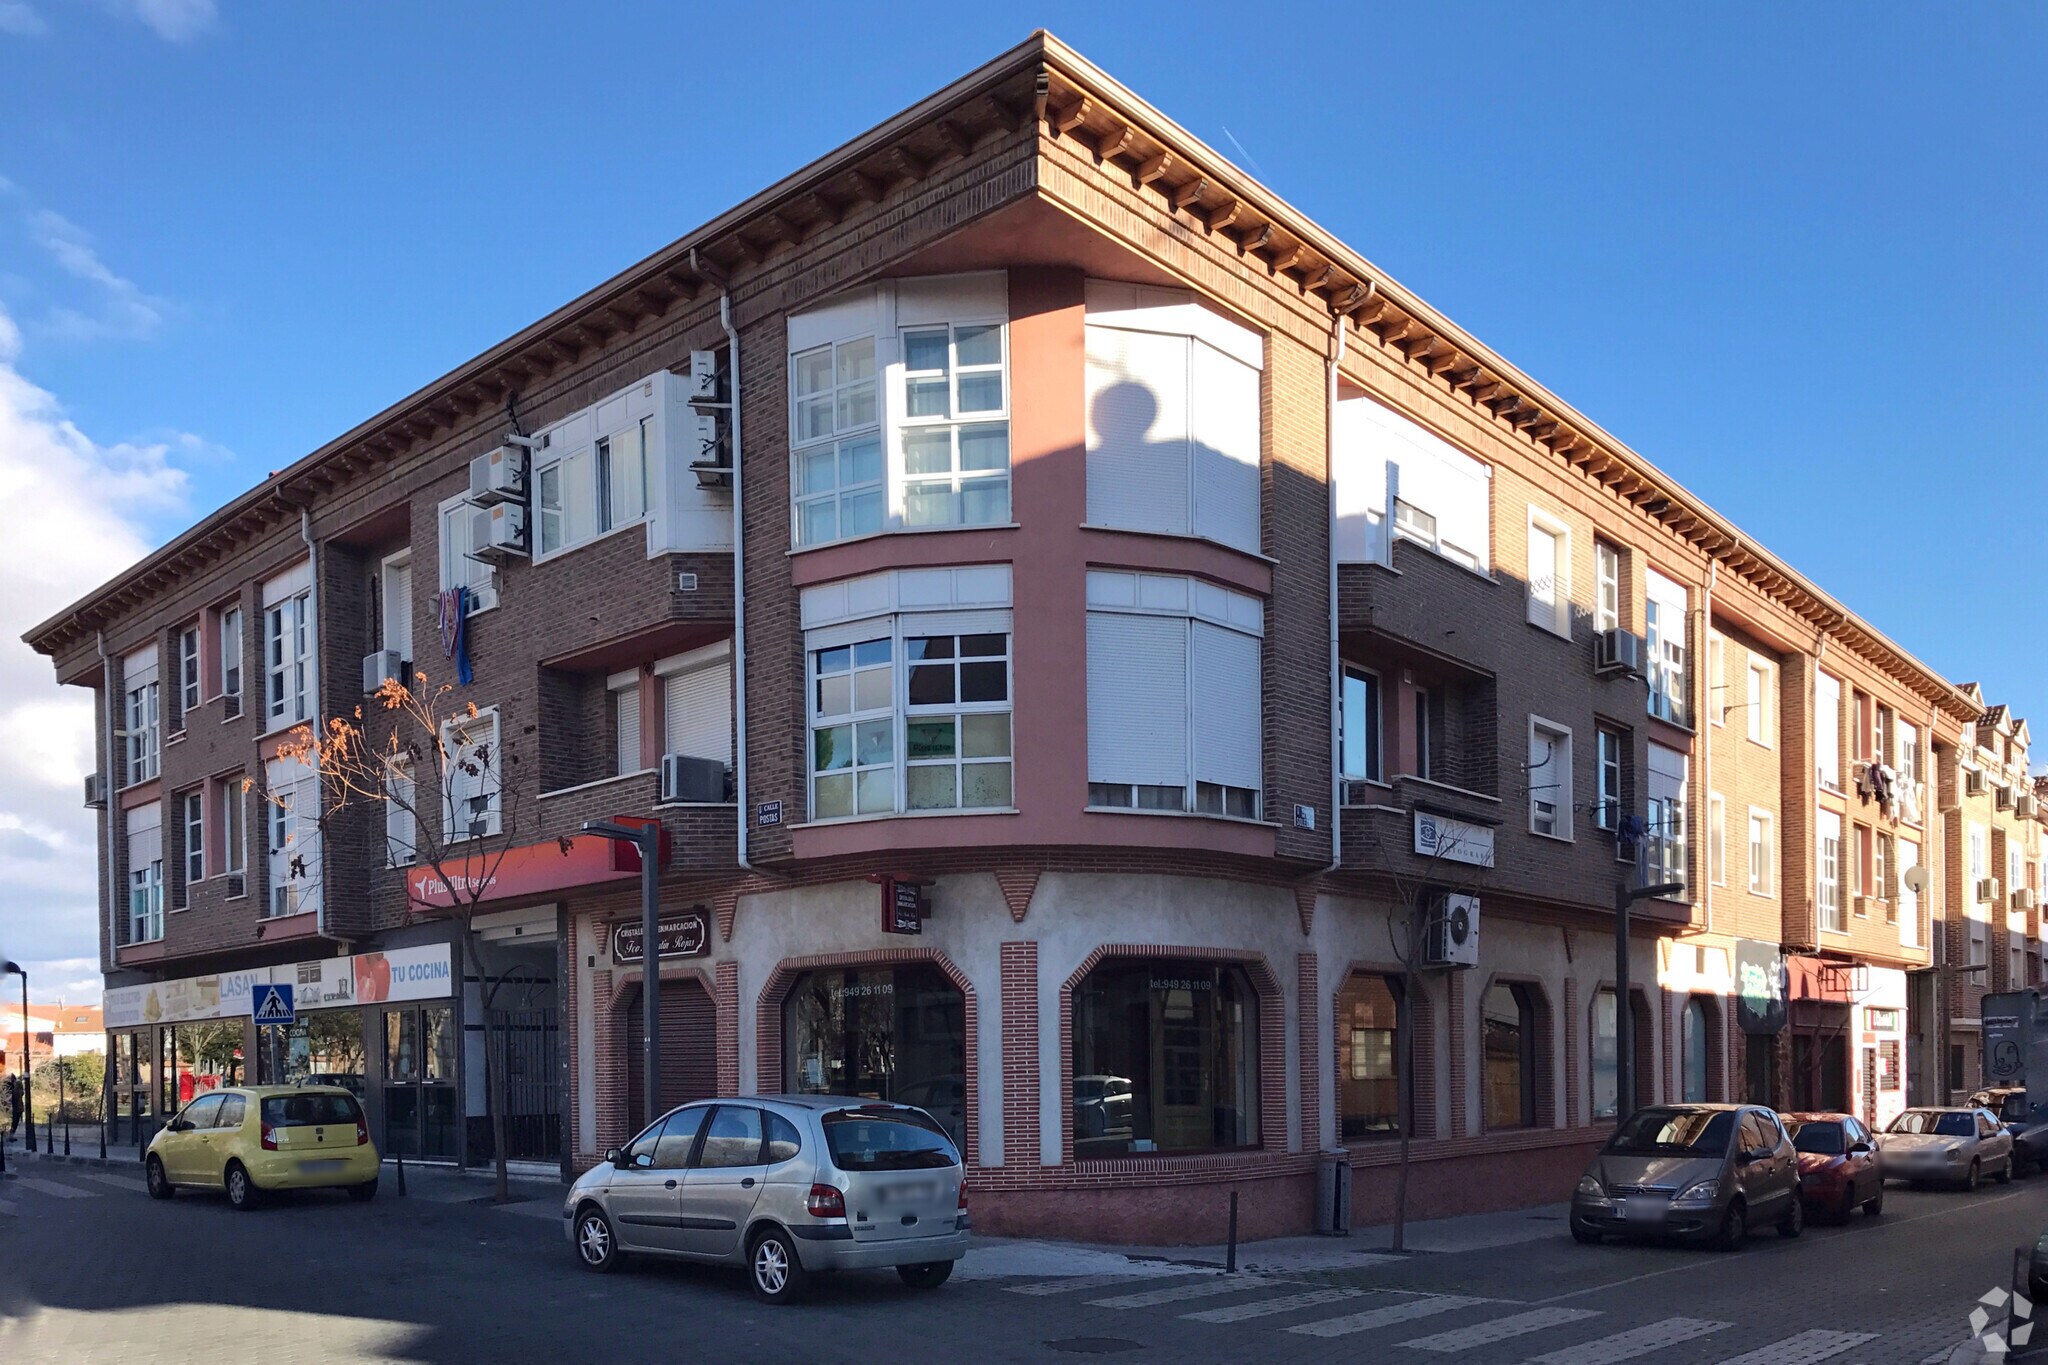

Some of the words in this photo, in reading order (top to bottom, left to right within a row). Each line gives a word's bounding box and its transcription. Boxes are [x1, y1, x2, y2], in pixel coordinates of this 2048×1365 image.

[763, 803, 779, 812] CALLE
[759, 813, 779, 825] POSTAS
[657, 921, 698, 933] ENMARCACION
[672, 935, 695, 951] Rojas
[391, 966, 407, 983] TU
[408, 961, 450, 982] COCINA
[861, 985, 872, 996] 26
[873, 984, 881, 995] 11
[882, 983, 893, 994] 09
[1181, 980, 1191, 990] 26
[1193, 980, 1200, 990] 11
[1201, 980, 1211, 990] 09
